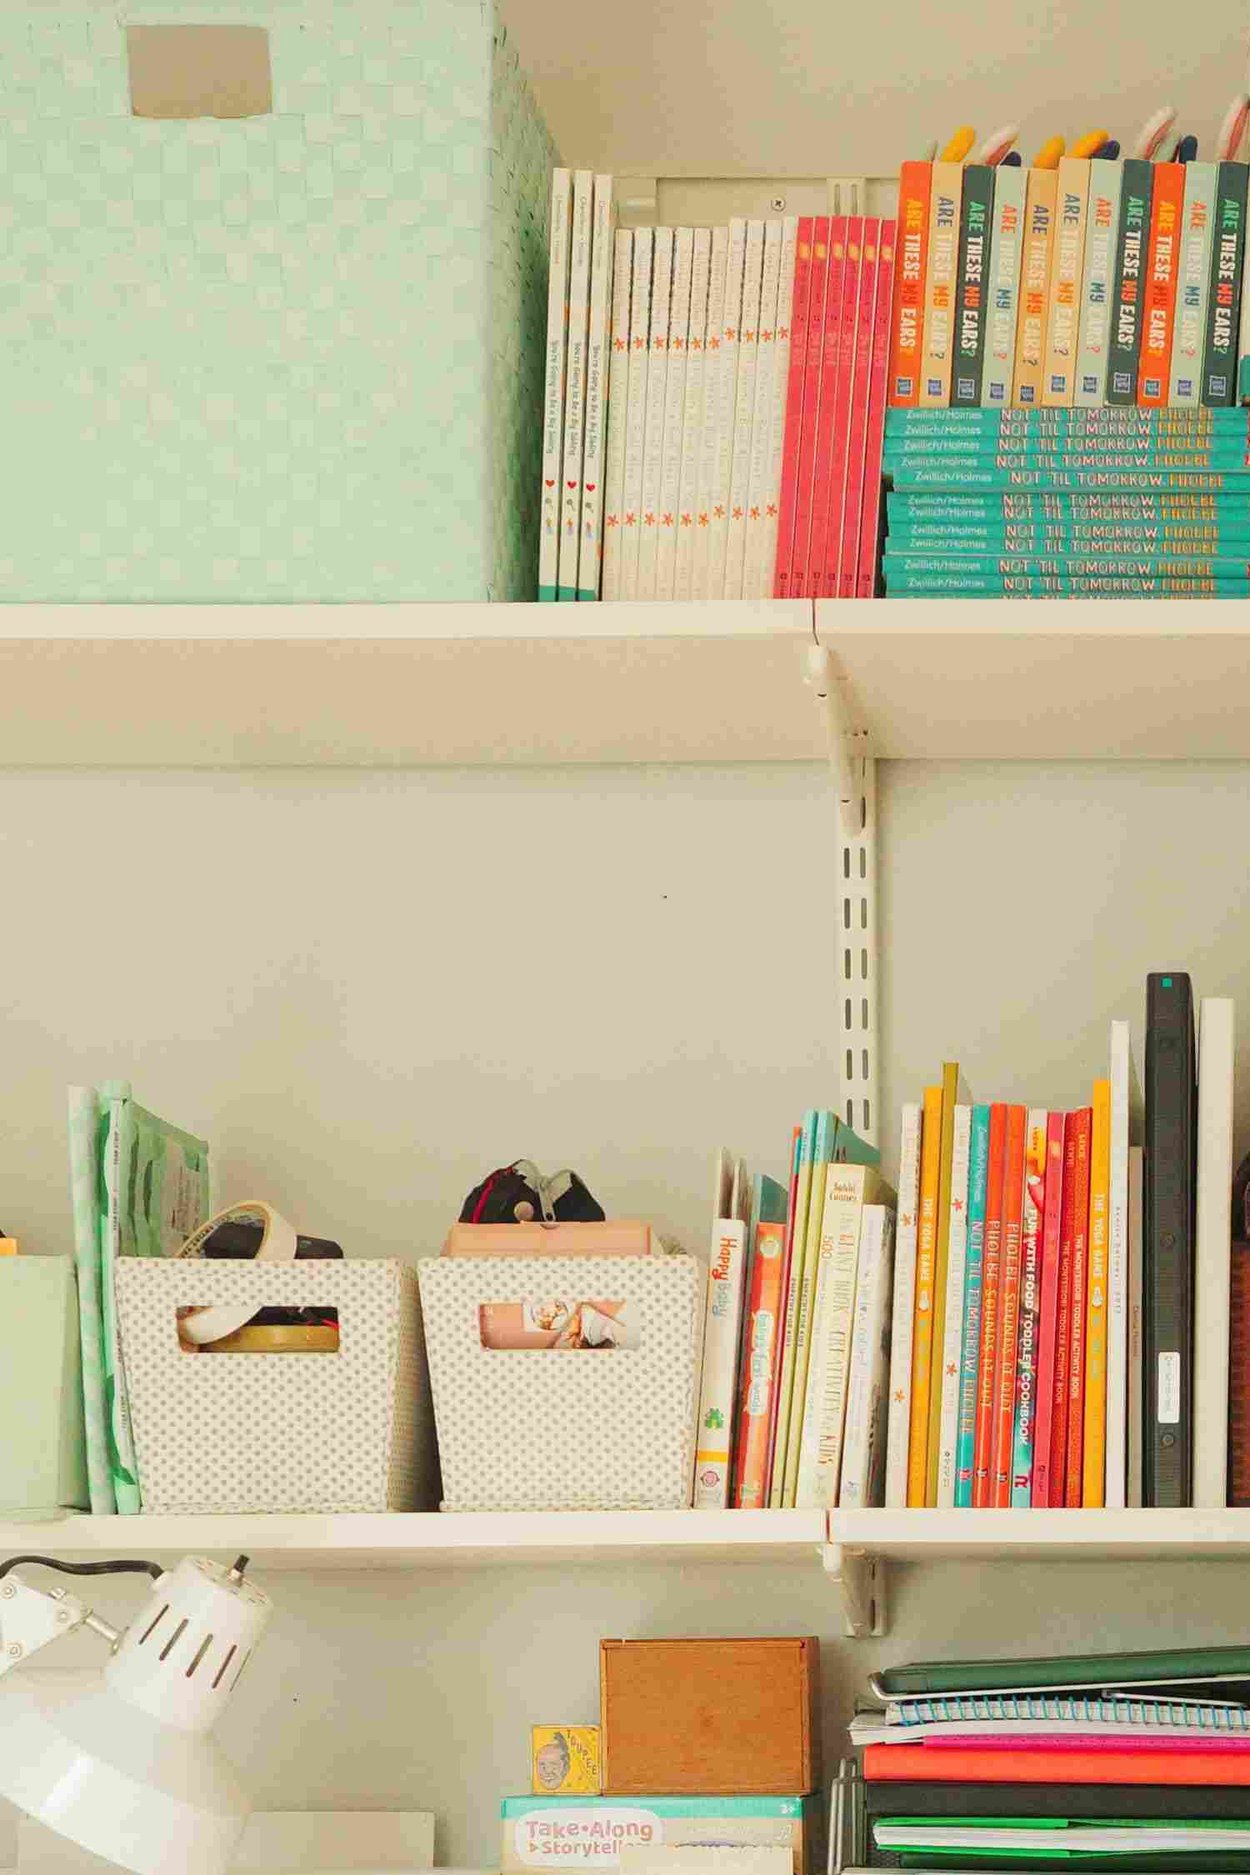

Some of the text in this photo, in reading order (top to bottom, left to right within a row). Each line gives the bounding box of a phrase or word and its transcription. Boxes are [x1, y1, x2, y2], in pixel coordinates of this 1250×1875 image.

[902, 198, 925, 281] ARE THESE
[964, 200, 986, 283] ARE THESE
[998, 437, 1029, 450] NOT
[710, 1238, 738, 1280] Happy
[1019, 1207, 1039, 1445] FUN WITH FOOD TODDLER COOKBOOK
[566, 1729, 598, 1776] TOUPEE
